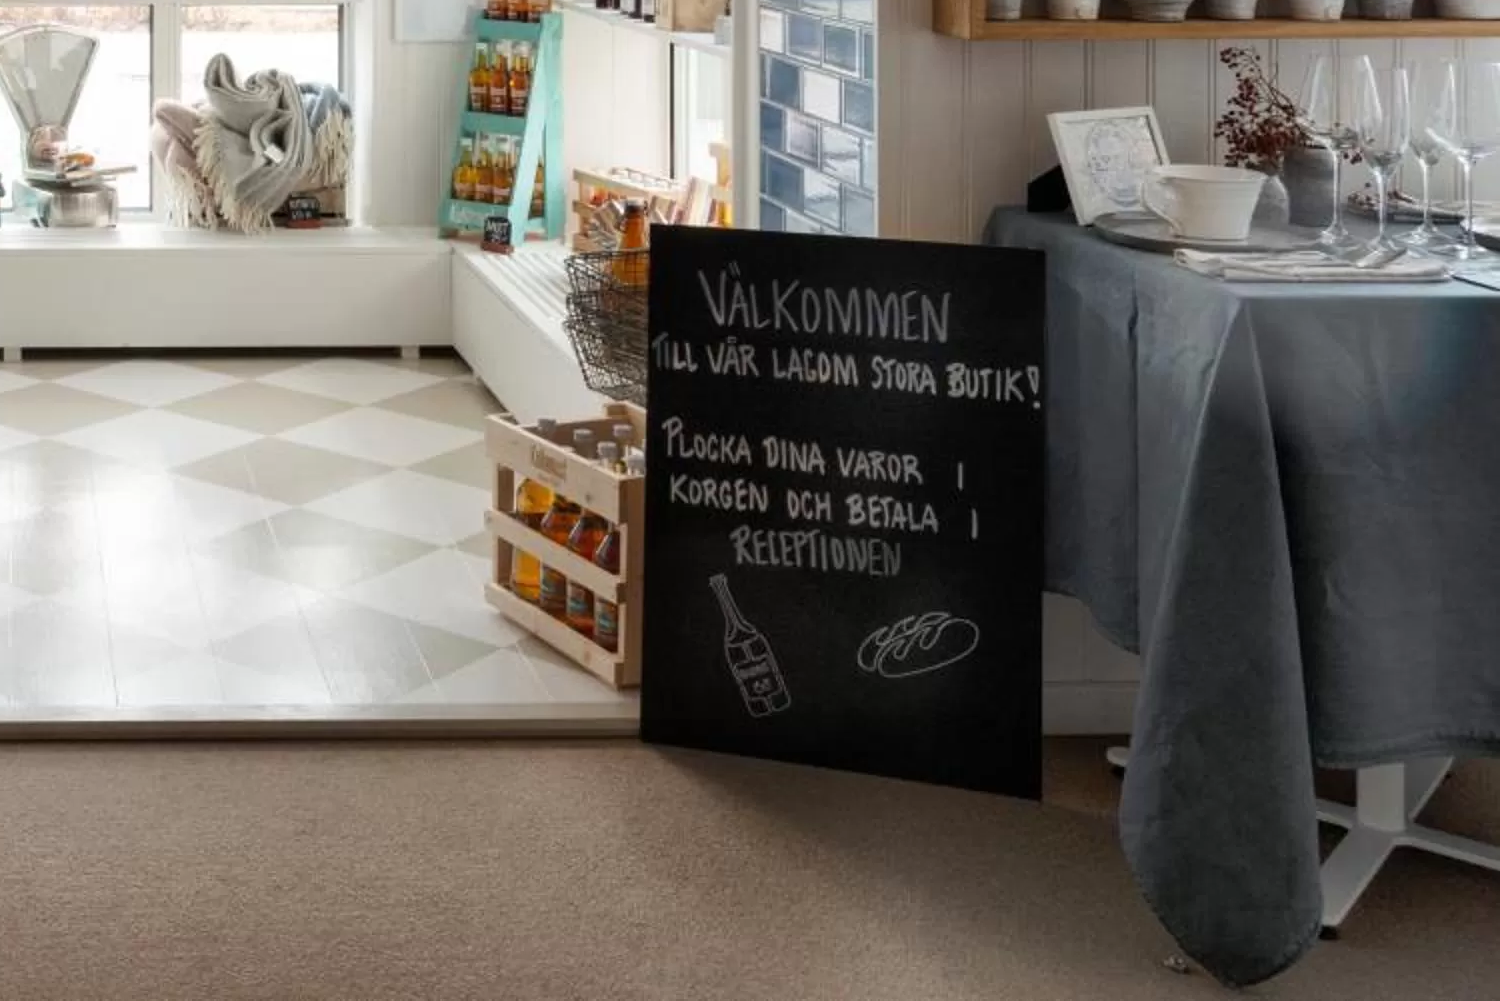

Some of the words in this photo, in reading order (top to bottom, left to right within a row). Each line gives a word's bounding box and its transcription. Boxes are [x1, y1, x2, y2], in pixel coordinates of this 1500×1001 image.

[698, 261, 951, 343] VÄLKOMMEN
[653, 332, 698, 372] TILL
[706, 336, 759, 376] VÅR
[772, 347, 859, 387] LAGOM
[871, 355, 936, 395] STORA
[947, 362, 1041, 409] BUTIK!
[662, 416, 752, 465] PLOCKA
[762, 435, 825, 475] DINA
[836, 447, 923, 485] VAROR
[669, 473, 769, 512] KORGEN
[787, 490, 832, 522] OCH
[846, 493, 939, 534] BETALA
[730, 524, 902, 576] RECEPTIONEN
